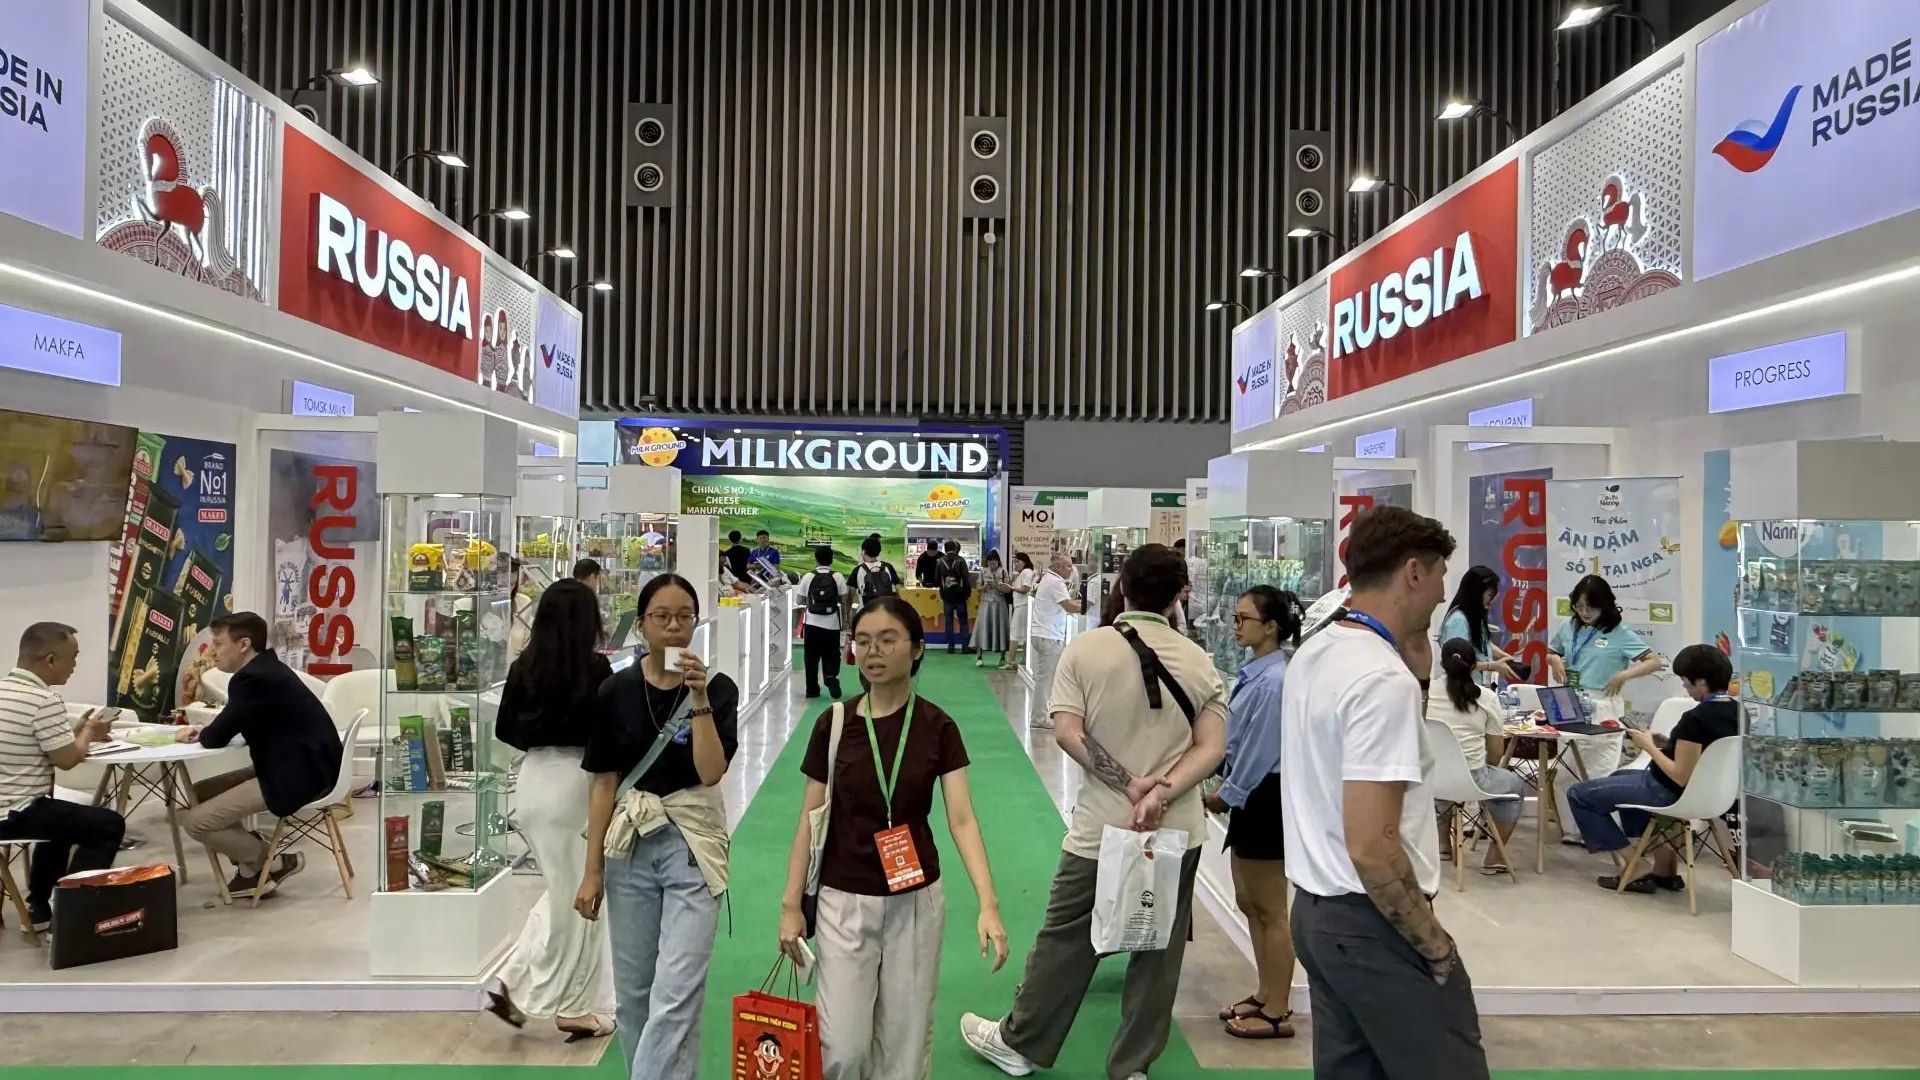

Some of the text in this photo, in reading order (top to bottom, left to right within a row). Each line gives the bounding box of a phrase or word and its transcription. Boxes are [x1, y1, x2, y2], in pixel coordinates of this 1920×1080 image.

[36, 67, 62, 105] IN
[1812, 37, 1912, 113] MADE
[317, 191, 473, 340] RUSSIA
[1333, 230, 1483, 360] RUSSIA
[34, 333, 85, 360] MAKFA
[1734, 359, 1811, 389] PROGRESS
[204, 461, 224, 470] BRAND
[701, 437, 989, 473] MILKGROUND
[705, 496, 741, 505] CHEESE
[749, 486, 755, 494] 1
[201, 511, 225, 520] MAKFA
[686, 506, 758, 516] MANUFACTURER
[1558, 527, 1640, 554] ĂN DẶM
[307, 465, 358, 677] RUSSI
[1565, 552, 1664, 578] SỐ 1 TẠI NGA
